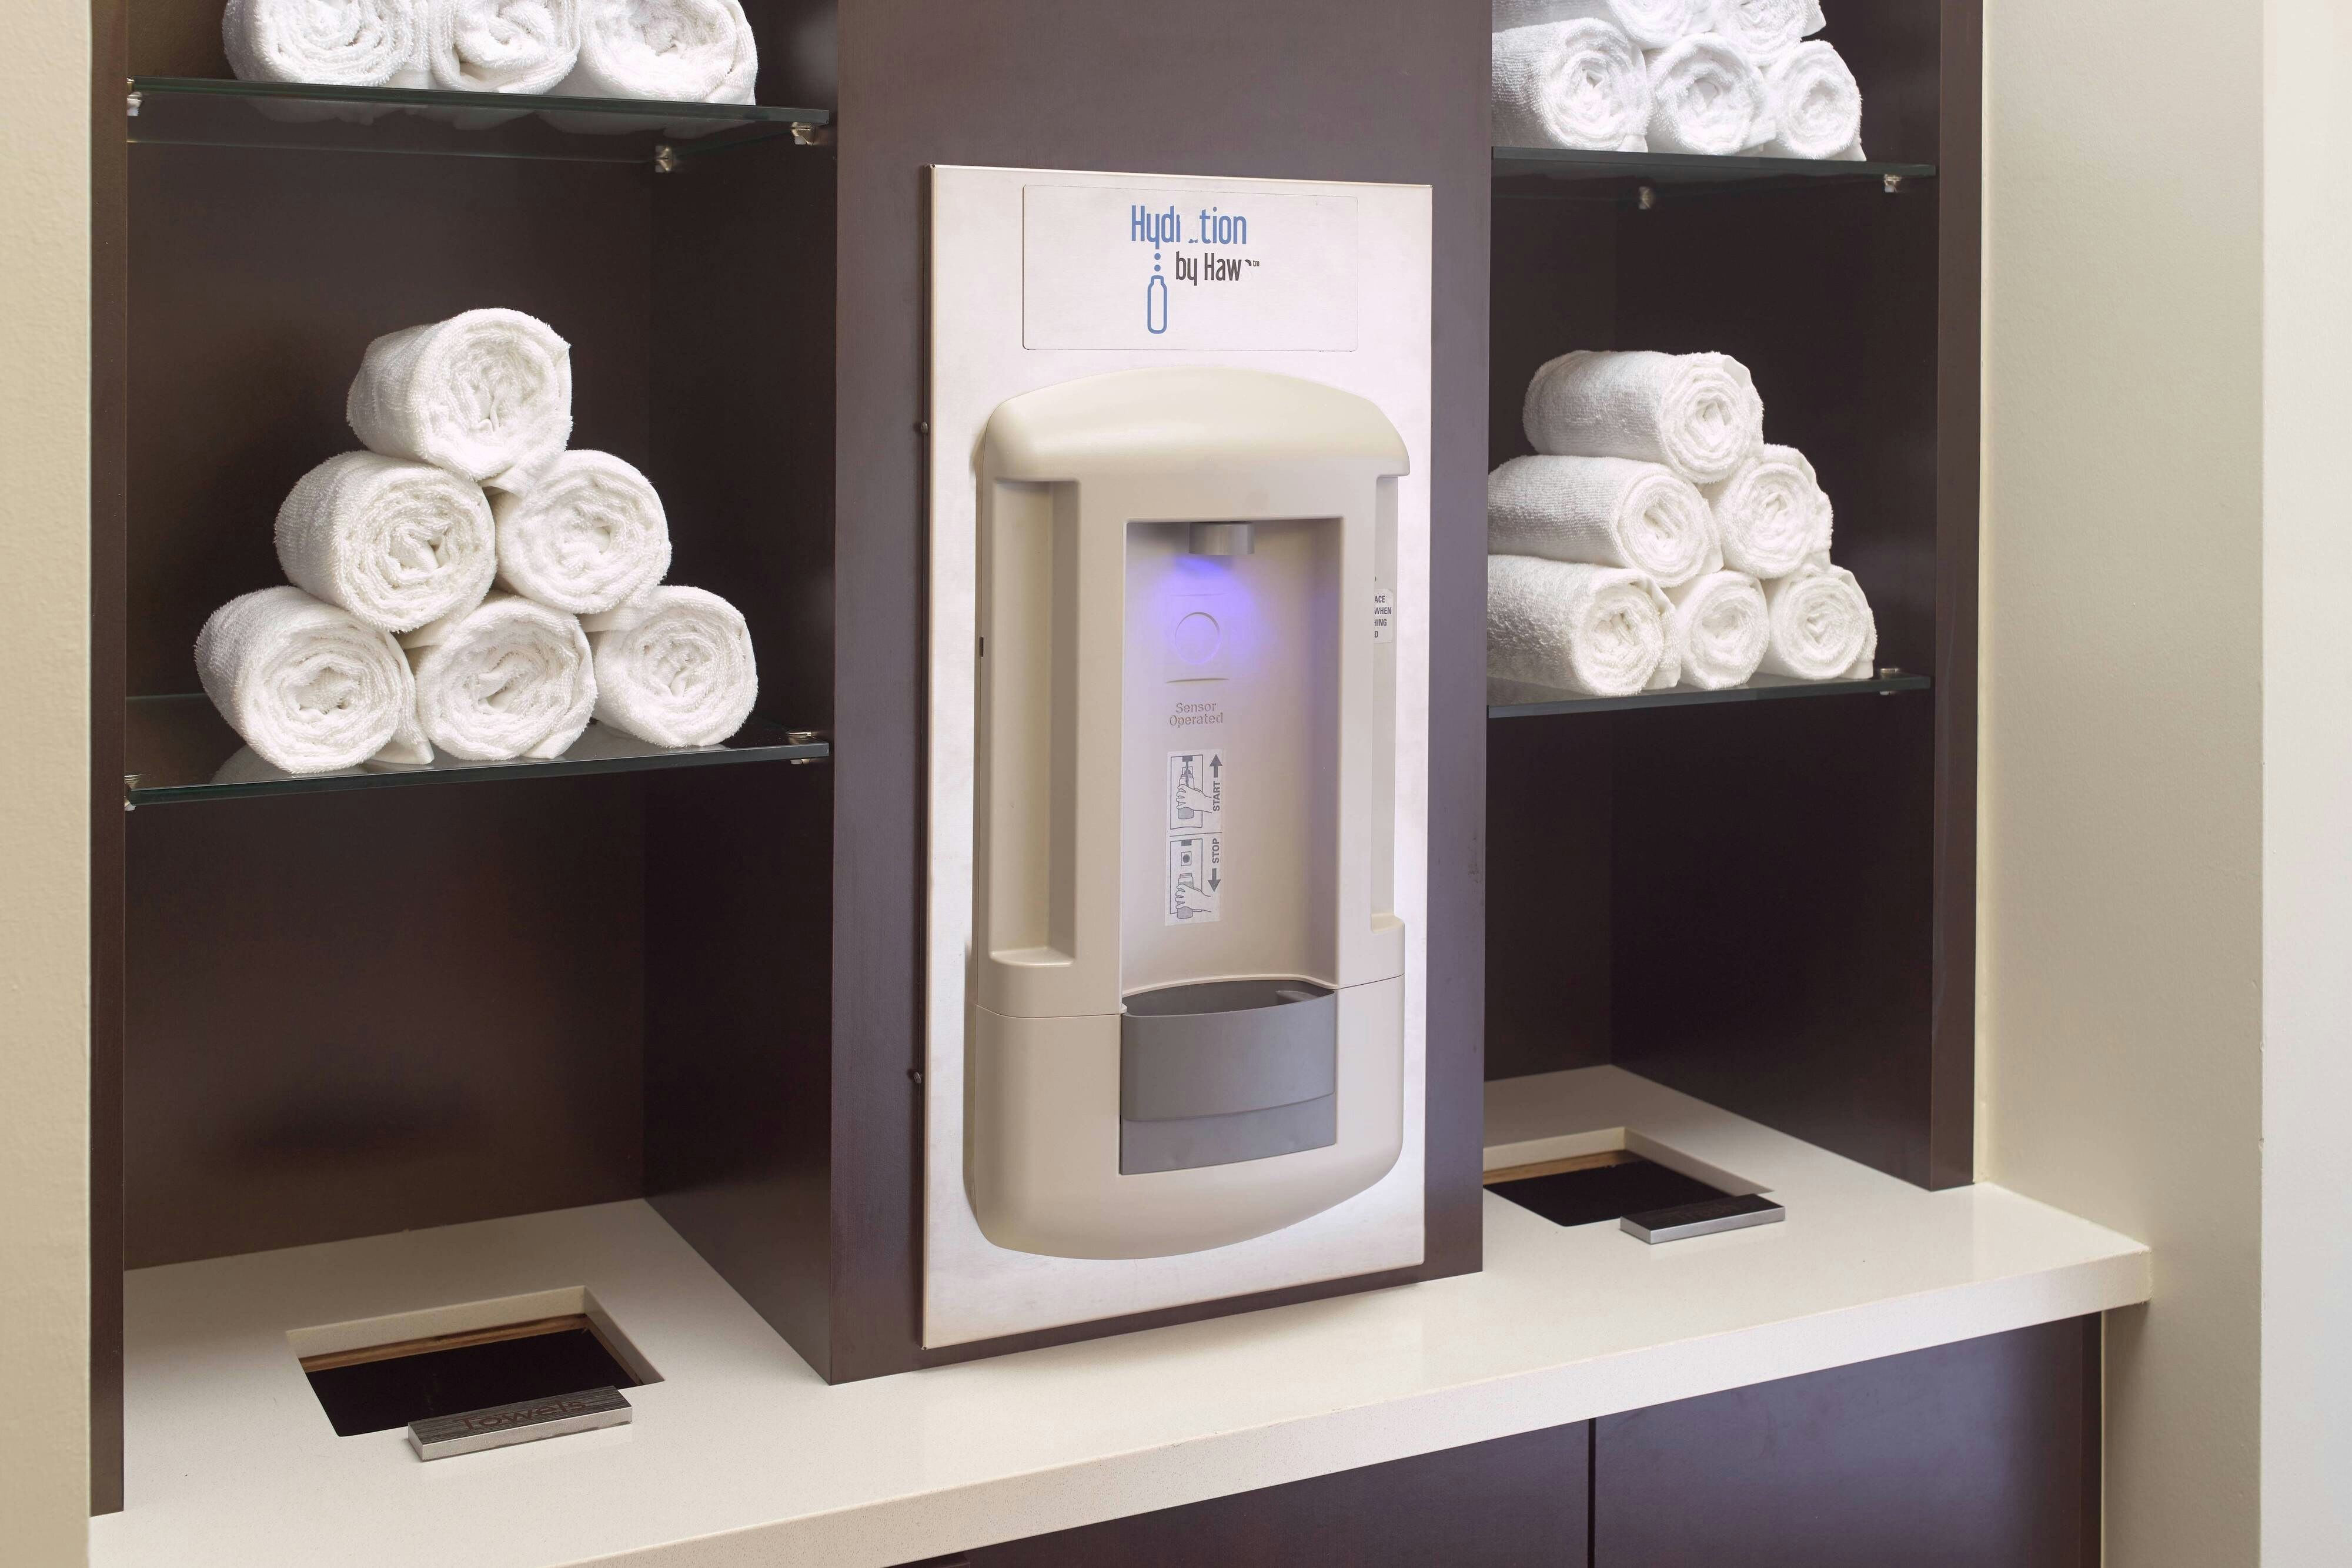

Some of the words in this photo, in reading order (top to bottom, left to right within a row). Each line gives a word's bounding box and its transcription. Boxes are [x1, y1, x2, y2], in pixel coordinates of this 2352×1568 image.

[1131, 205, 1247, 249] Hydrtion
[1176, 251, 1197, 286] by
[1170, 712, 1223, 728] Operated
[1176, 703, 1217, 713] Sensor
[460, 1399, 587, 1430] Towels
